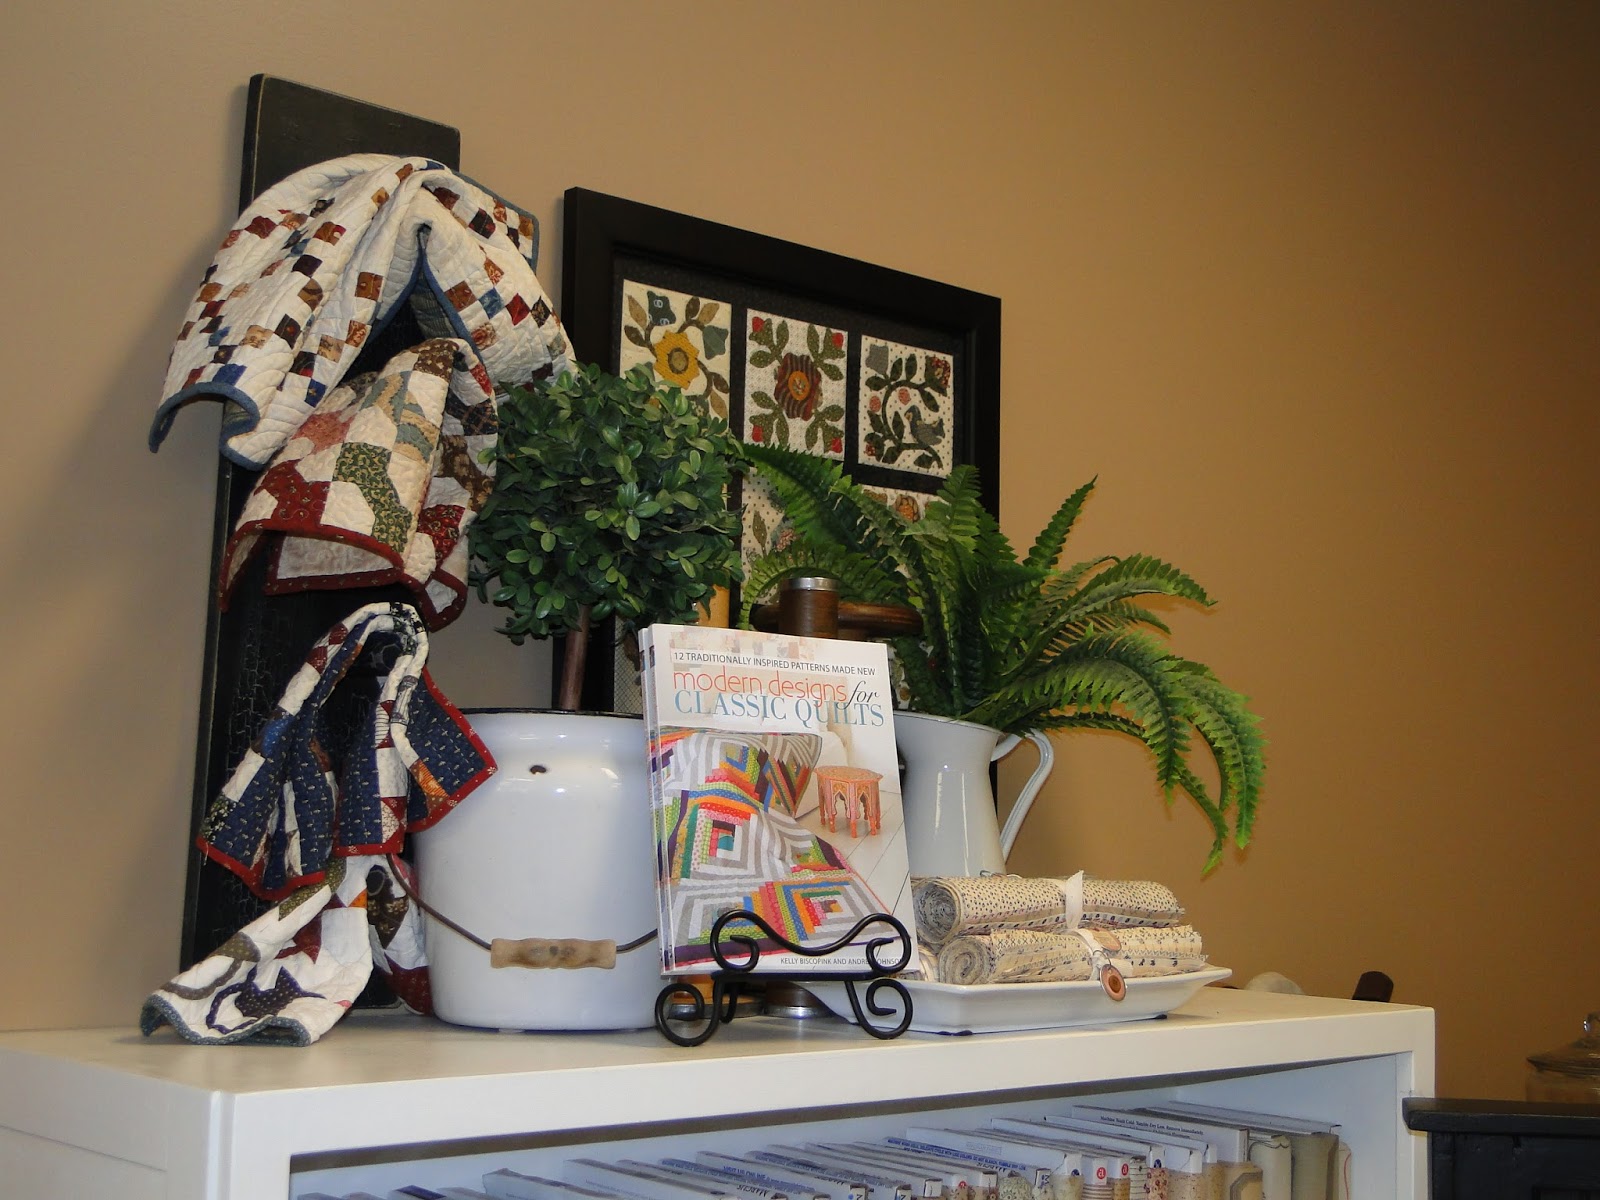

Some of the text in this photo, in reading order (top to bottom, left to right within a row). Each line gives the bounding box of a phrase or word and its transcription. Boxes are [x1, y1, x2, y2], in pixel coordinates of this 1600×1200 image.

[674, 652, 876, 676] 12 TRADITIONALLY INSPIRED PATTERNS MADE NEW
[673, 666, 880, 710] modern designs for
[675, 690, 885, 729] CLASSIC QUILTS
